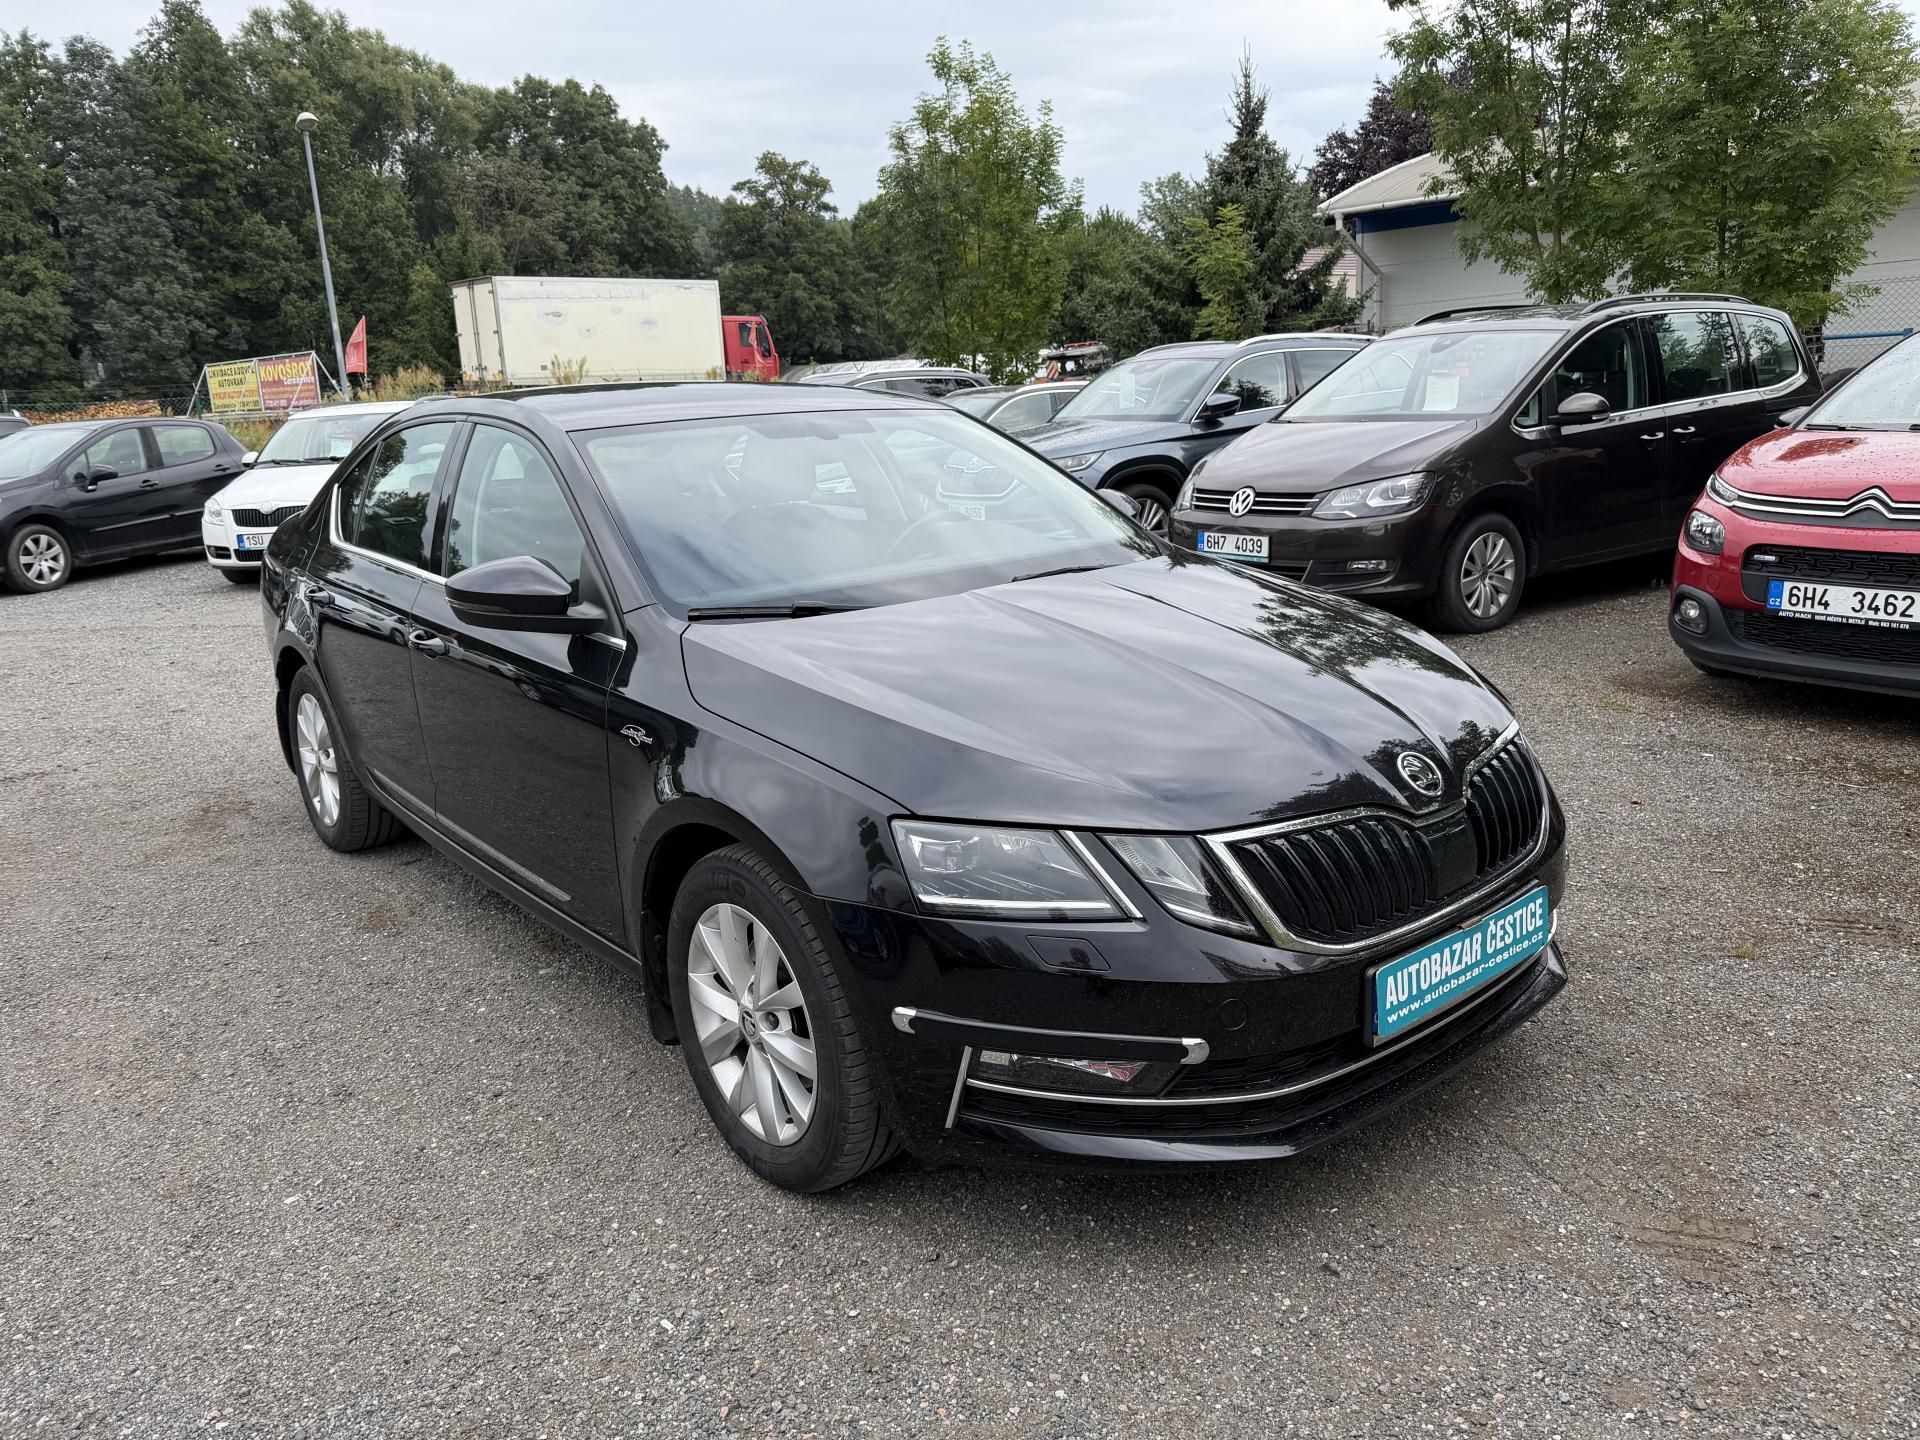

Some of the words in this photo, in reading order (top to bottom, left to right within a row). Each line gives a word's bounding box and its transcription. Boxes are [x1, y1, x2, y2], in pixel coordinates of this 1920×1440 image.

[246, 535, 264, 546] 1SU
[1206, 534, 1227, 550] 6H7
[1234, 537, 1263, 554] 4039
[1769, 598, 1781, 606] CZ
[1787, 585, 1830, 610] 6H4
[1851, 591, 1916, 618] 3462
[1385, 932, 1482, 1010] AUTOBAZAR
[1486, 897, 1544, 954] ČESTICE
[1387, 931, 1543, 1024] www.autobazar-cestice.cz
